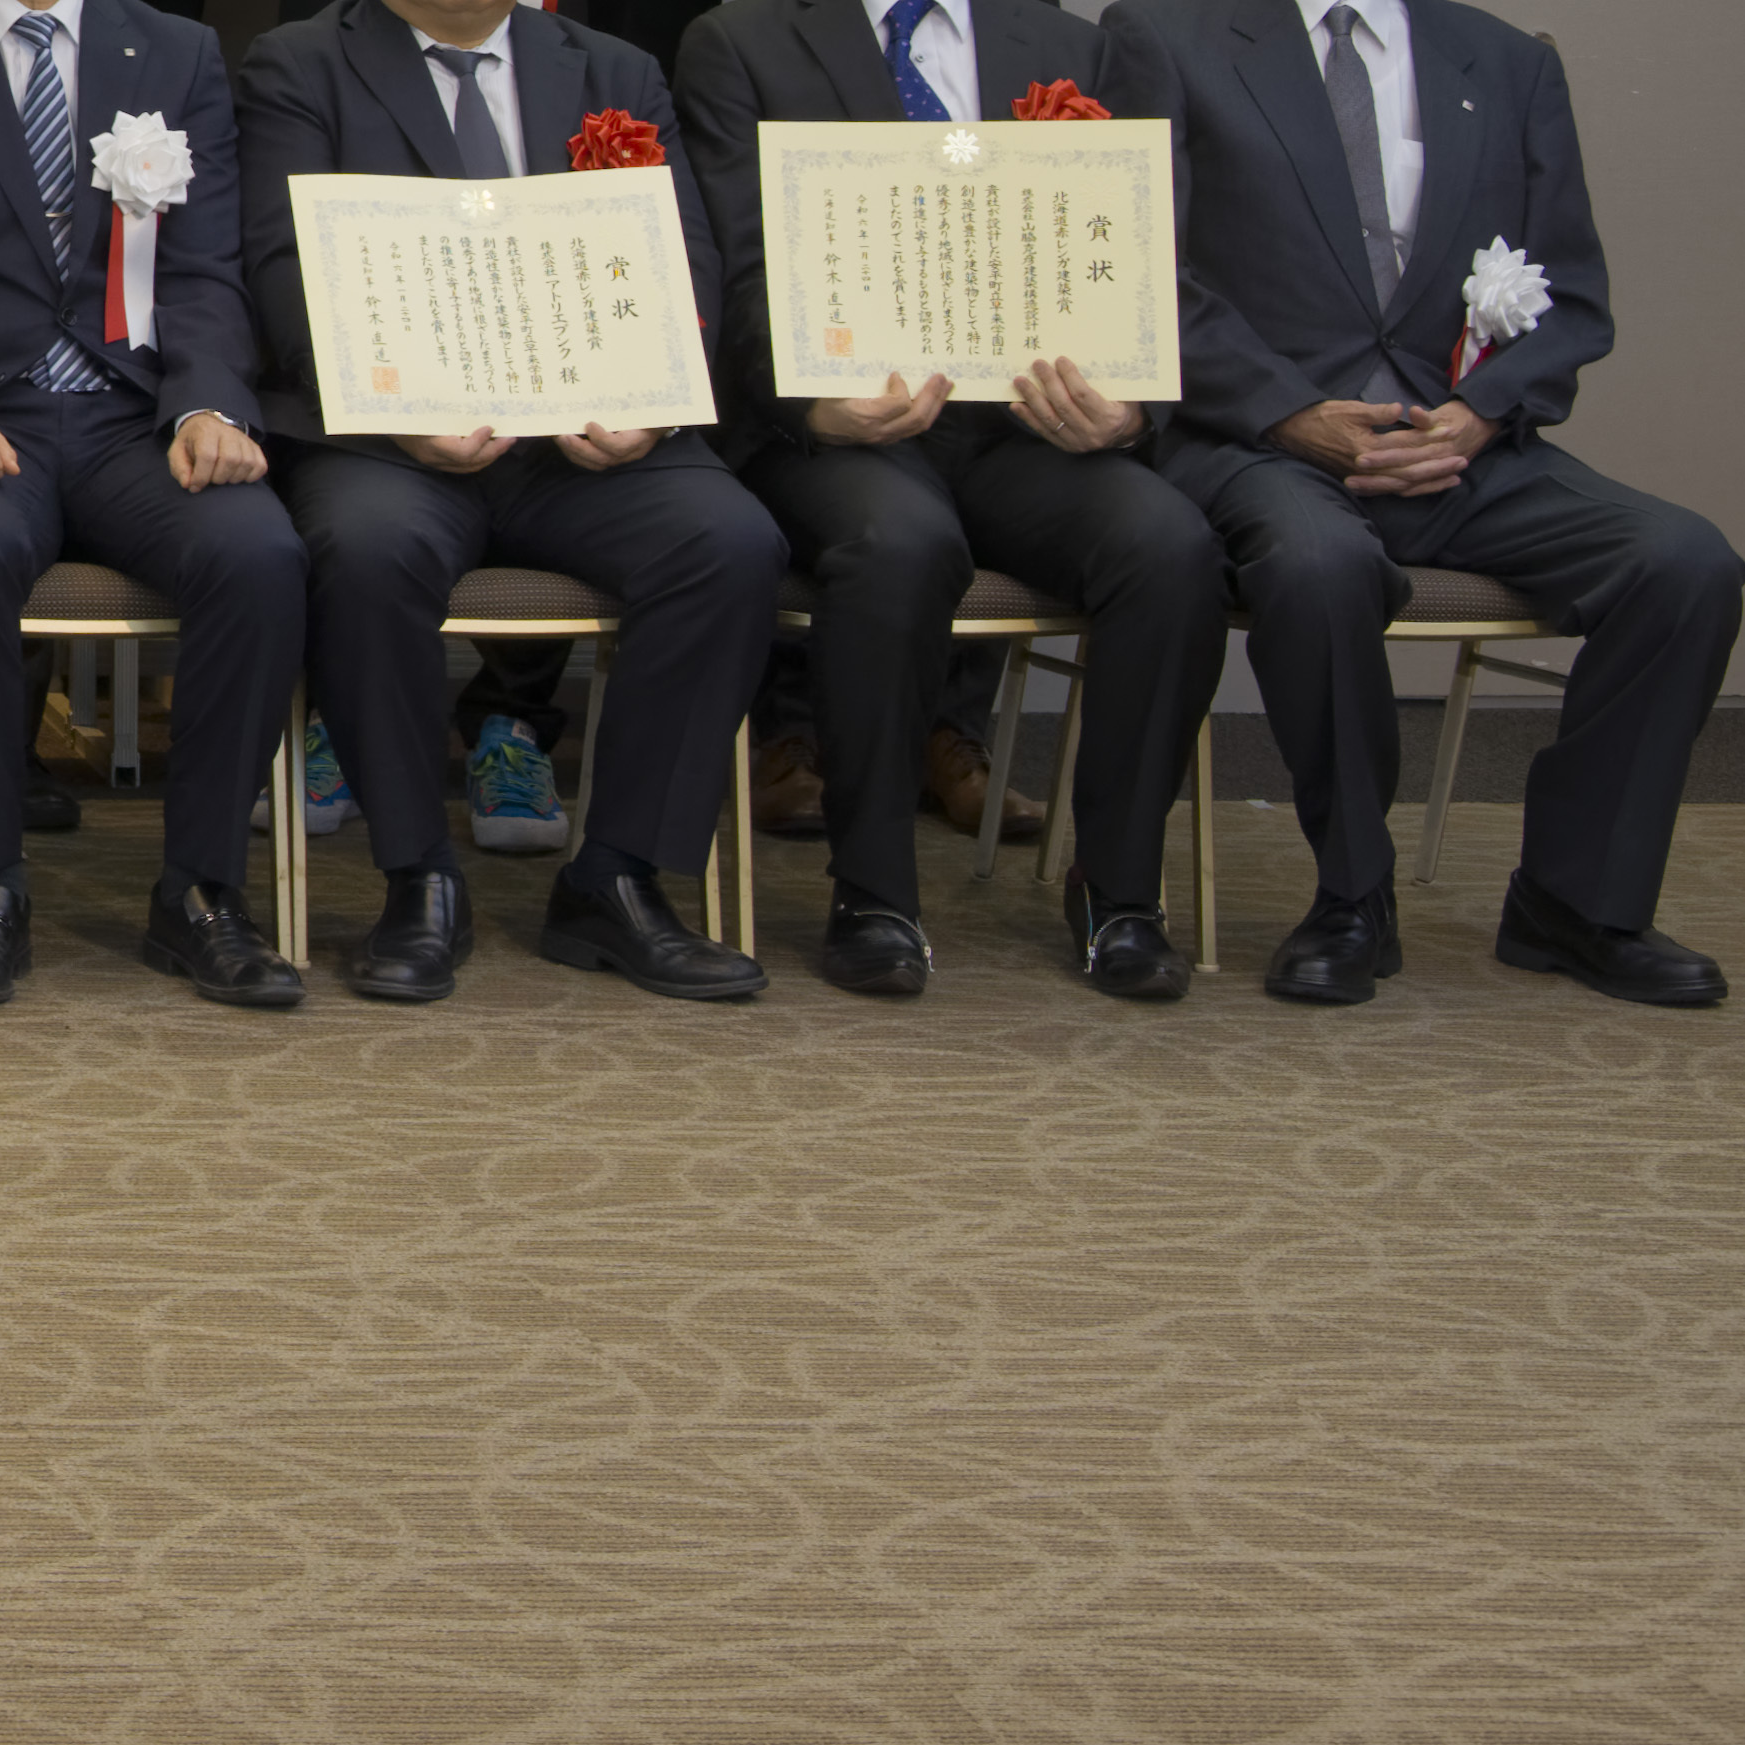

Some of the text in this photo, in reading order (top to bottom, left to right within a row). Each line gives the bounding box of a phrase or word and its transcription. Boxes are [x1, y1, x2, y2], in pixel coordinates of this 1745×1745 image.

[571, 237, 602, 350] 北海道赤レンガ建築賞
[605, 256, 639, 320] 賞状
[1053, 191, 1073, 314] 北海道赤レンガ建築賞
[1086, 215, 1115, 283] 賞状
